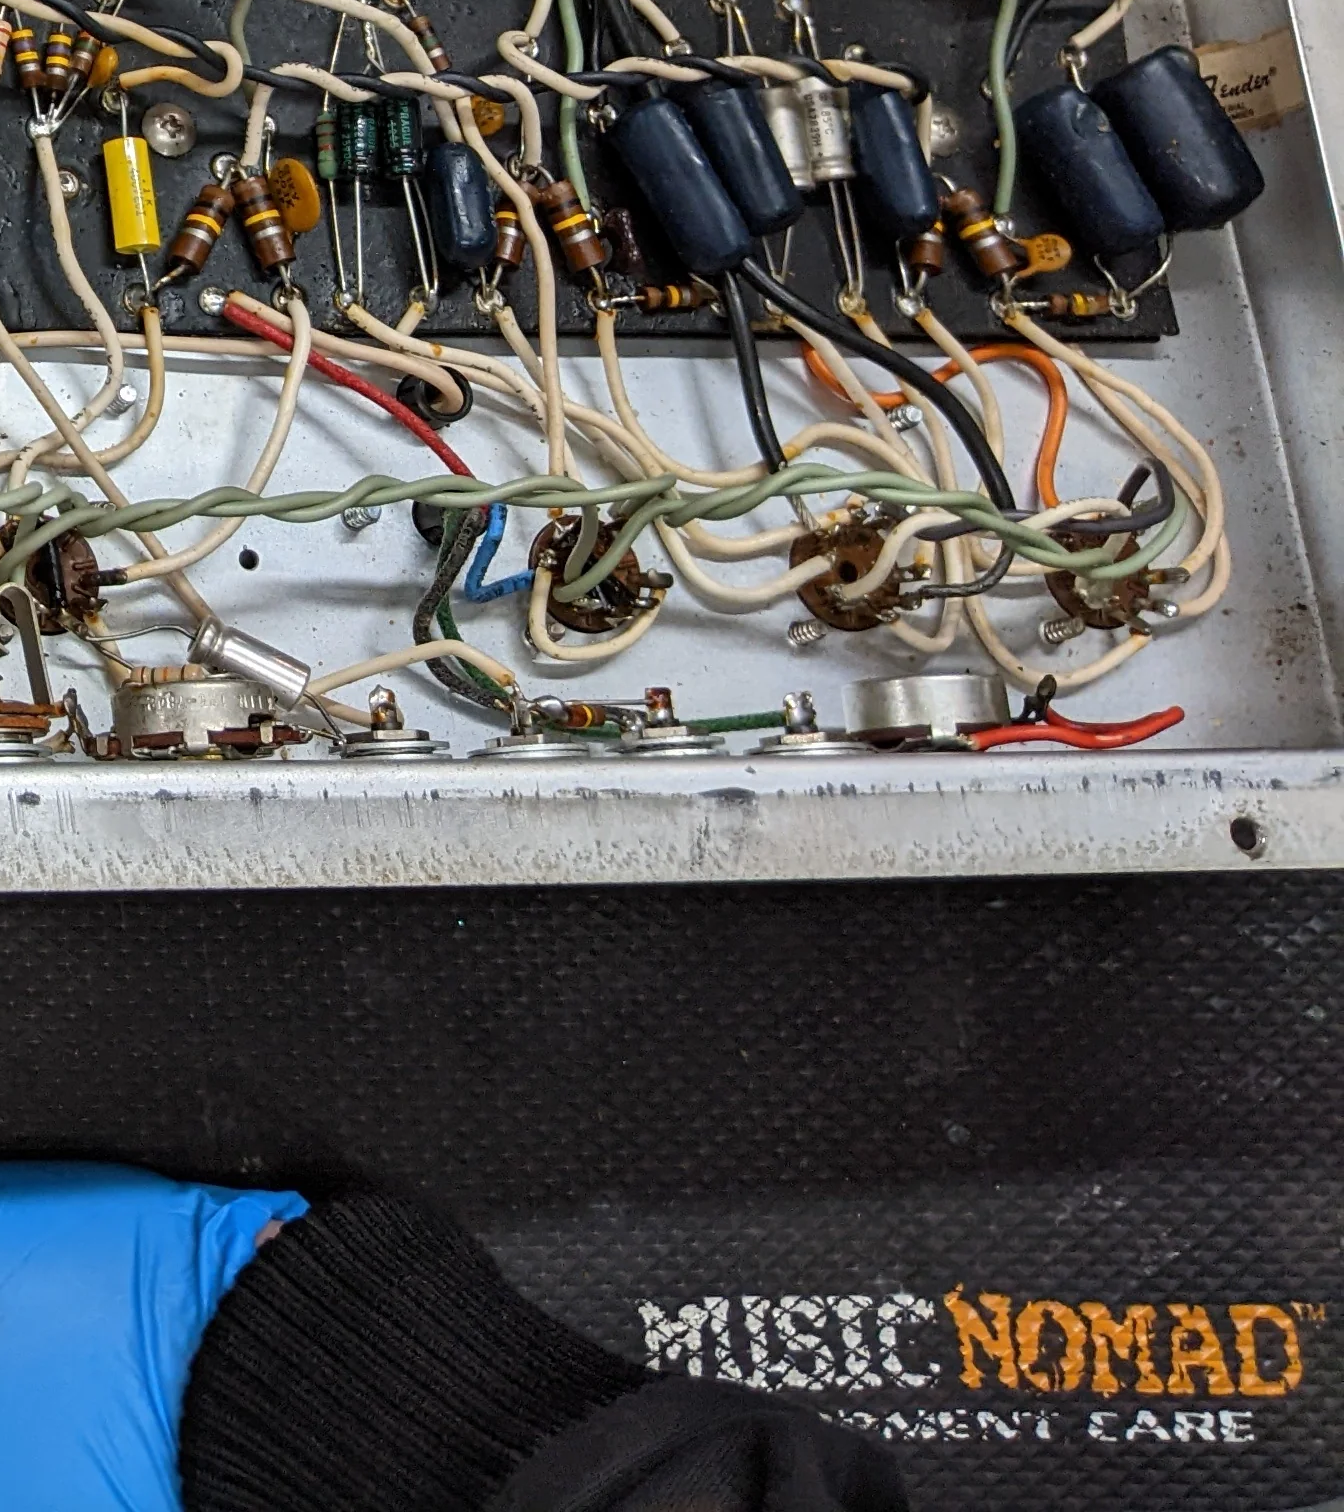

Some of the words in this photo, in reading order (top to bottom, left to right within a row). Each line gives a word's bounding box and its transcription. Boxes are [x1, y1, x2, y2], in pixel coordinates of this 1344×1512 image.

[635, 1292, 942, 1392] MUSIC
[943, 1282, 1306, 1400] NOMAD
[1086, 1409, 1257, 1444] CARE
